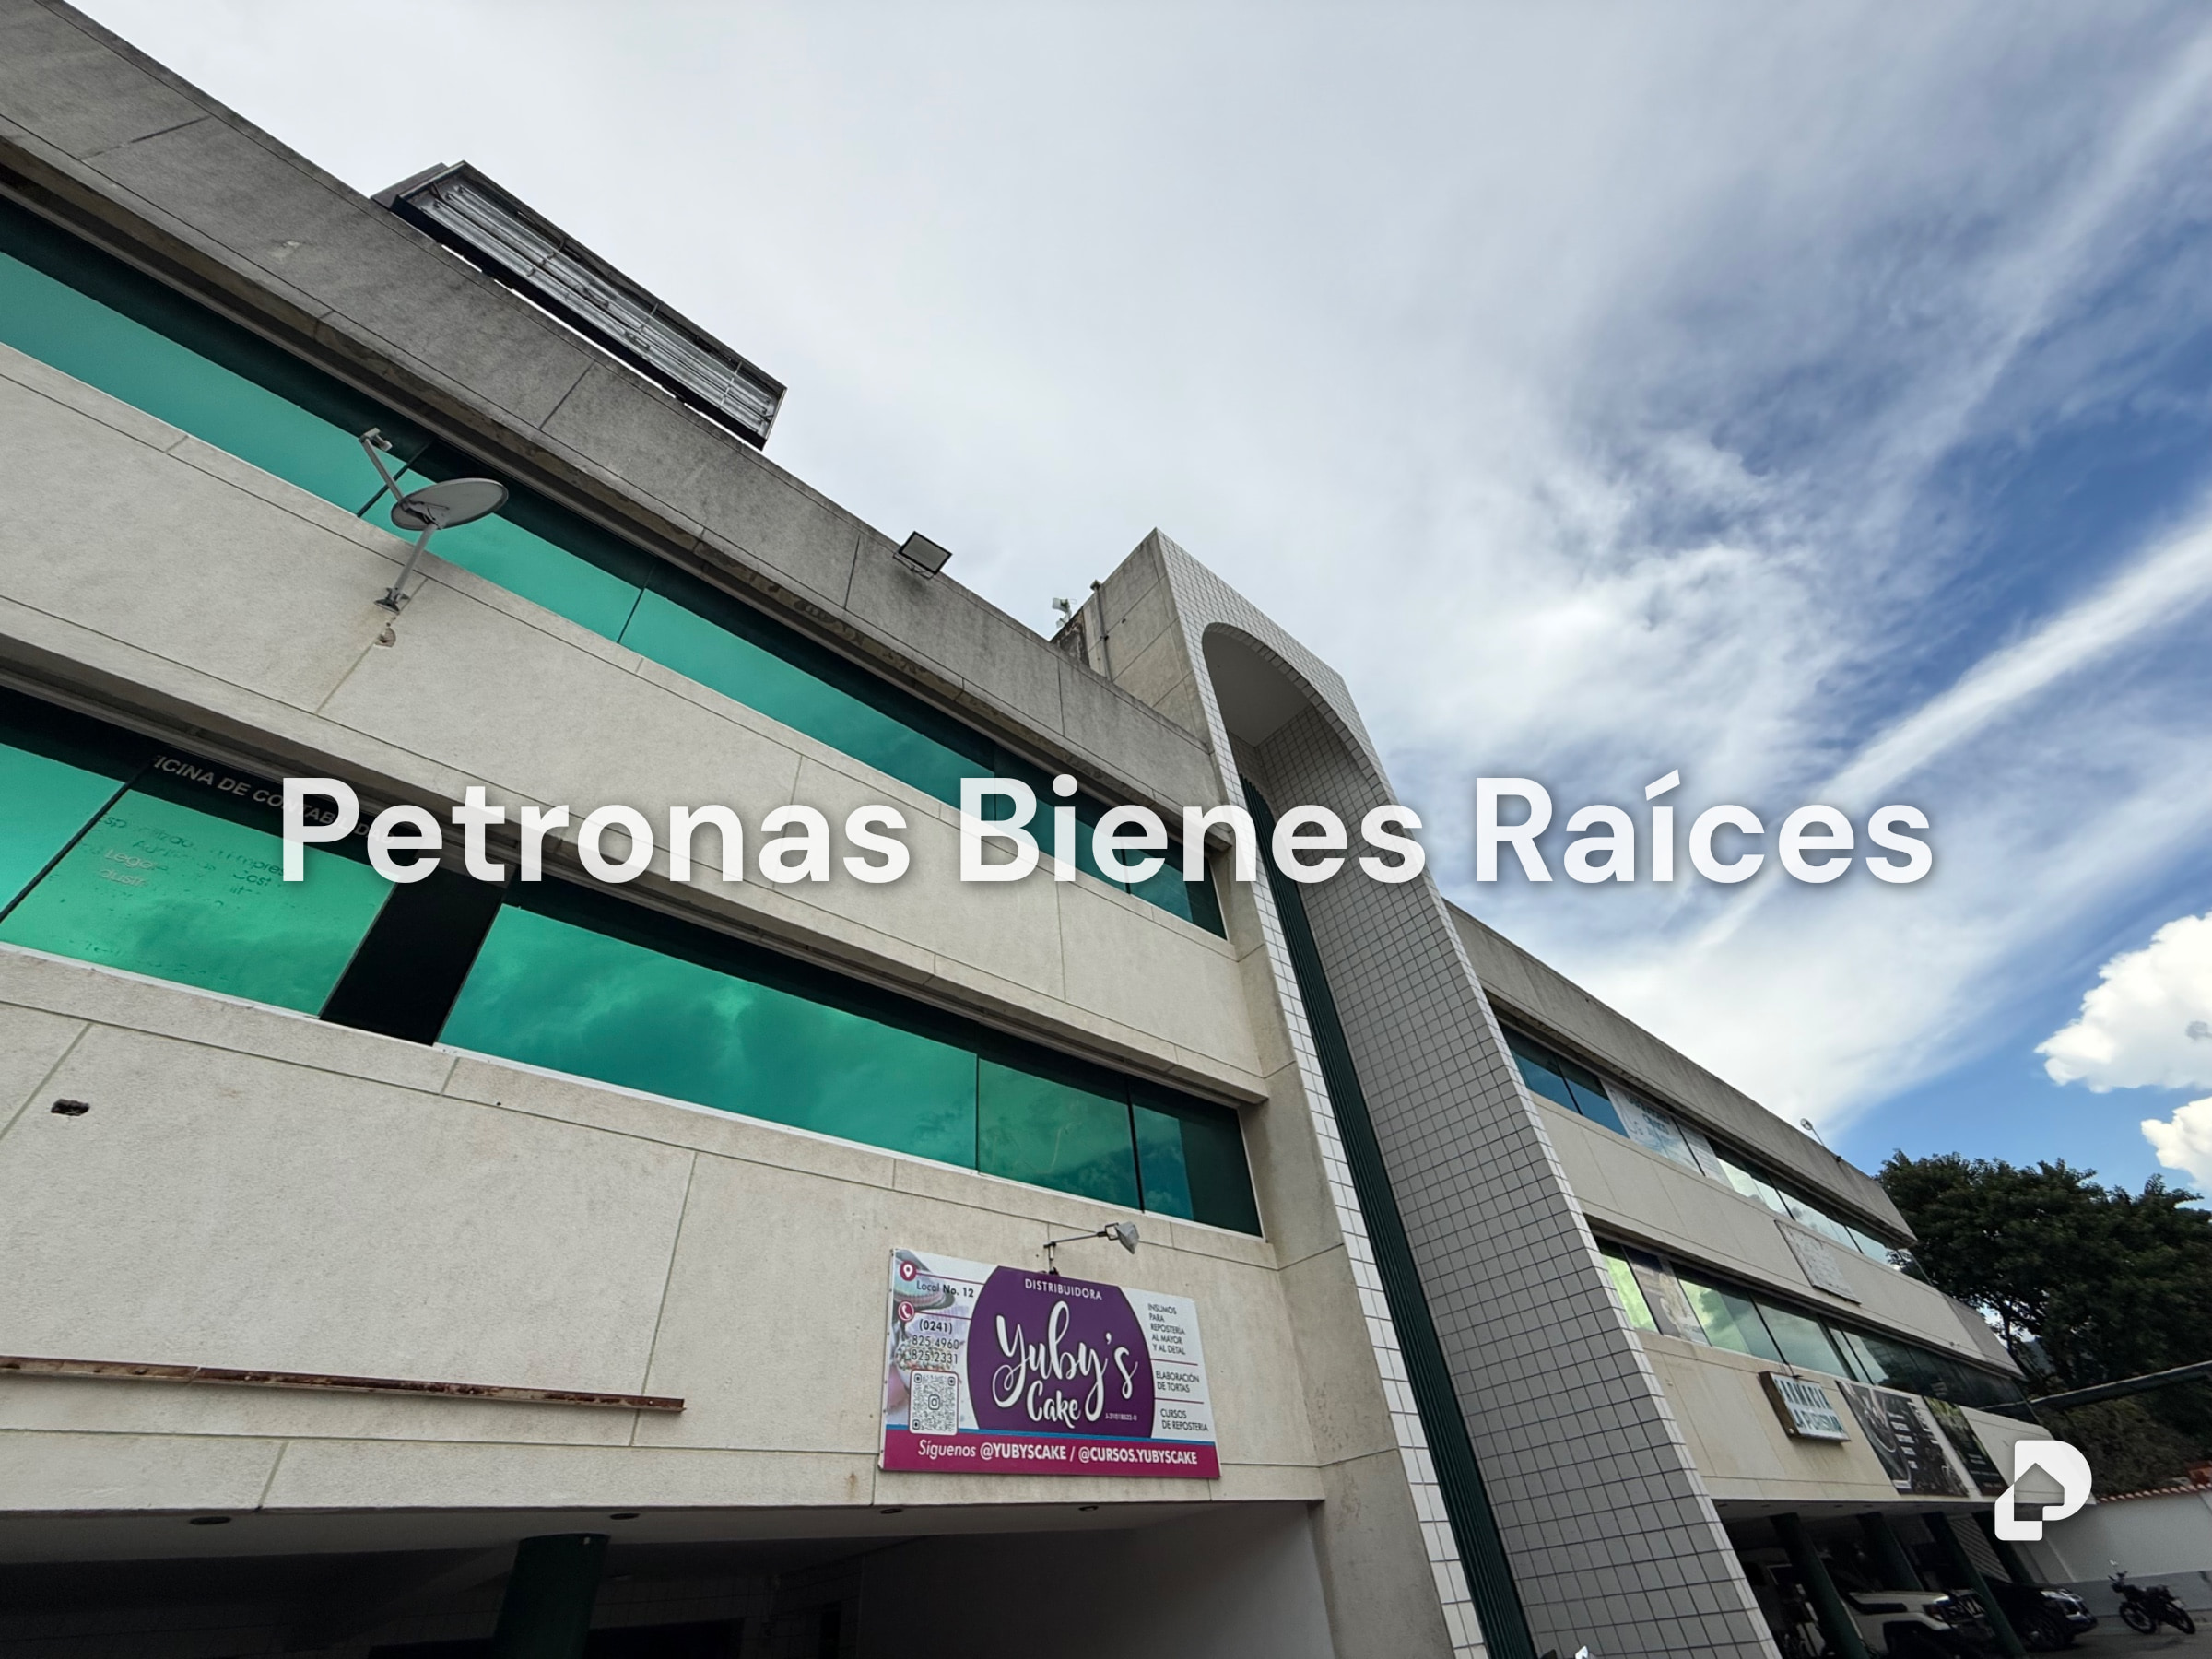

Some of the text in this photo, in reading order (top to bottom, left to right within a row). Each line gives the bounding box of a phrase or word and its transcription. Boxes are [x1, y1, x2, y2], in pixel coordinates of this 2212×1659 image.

[152, 754, 214, 786] ICINA
[217, 777, 252, 796] DE
[916, 1280, 974, 1298] Local No. 12
[1024, 1278, 1103, 1301] DISTRIBUIDORA
[1147, 1303, 1178, 1315] INSUMOS
[1148, 1312, 1166, 1323] PARA
[919, 1319, 953, 1335] (0241)
[912, 1335, 959, 1350] 825.4960
[1151, 1334, 1183, 1345] AL MAYOR
[911, 1349, 959, 1365] 825.2331
[1159, 1344, 1166, 1353] AL
[1167, 1345, 1186, 1356] DETAL
[992, 1300, 1139, 1422] Yuby's
[1157, 1381, 1191, 1394] DE TORTAS
[1026, 1380, 1081, 1429] Cake
[1160, 1408, 1187, 1419] CURSOS
[1161, 1419, 1171, 1430] DE
[917, 1439, 977, 1460] Síguenos
[979, 1442, 1067, 1461] @YUBYSCAKE
[1077, 1446, 1198, 1465] @CURSOS.YUBYSCAKE
